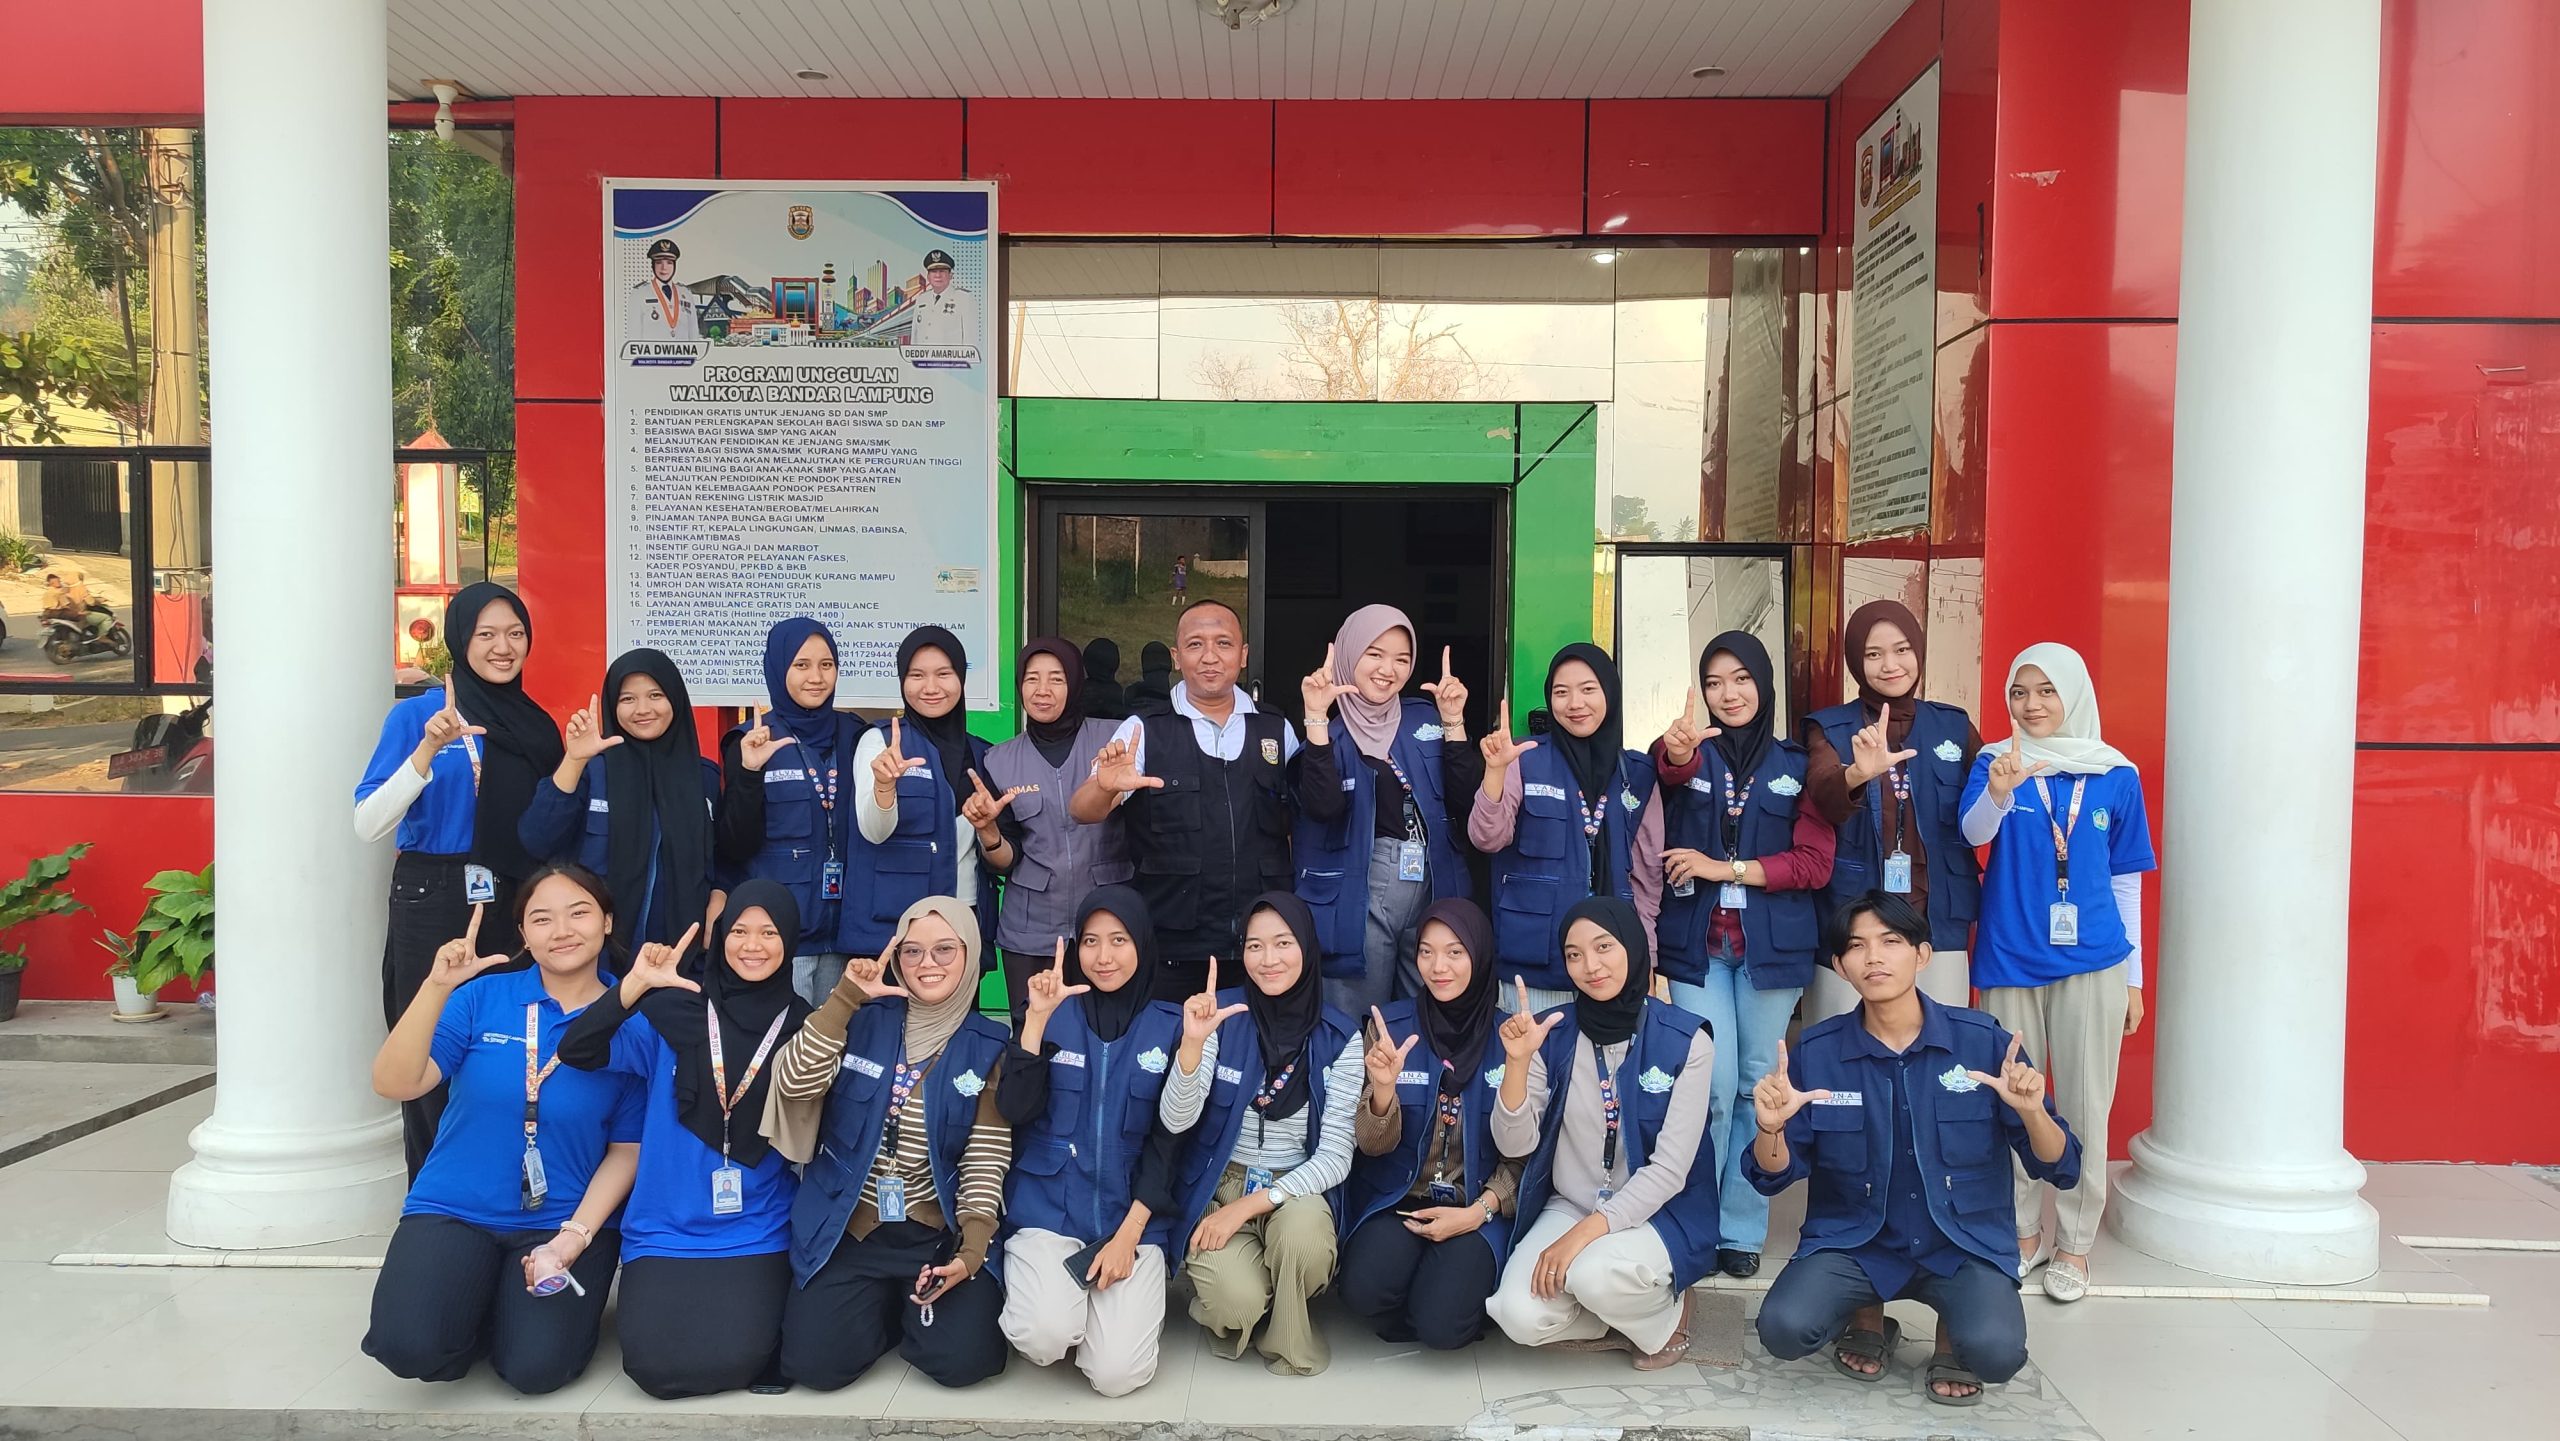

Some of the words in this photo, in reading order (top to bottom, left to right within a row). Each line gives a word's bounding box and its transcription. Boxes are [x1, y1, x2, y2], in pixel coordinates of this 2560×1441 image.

[630, 344, 651, 355] EVA
[654, 344, 698, 356] DWIANA
[905, 350, 929, 359] DEDDY
[930, 350, 976, 359] AMARULLAH
[704, 366, 793, 382] PROGRAM
[796, 367, 899, 384] UNGGULAN
[669, 385, 763, 402] WALIKOTA
[766, 386, 842, 403] BANDAR
[844, 387, 934, 404] LAMPUNG
[707, 409, 741, 417] GRATIS
[695, 419, 773, 427] PERLENGKAPAN
[853, 420, 883, 428] SISWA
[886, 420, 898, 428] SD
[902, 420, 922, 428] DAN
[720, 438, 779, 446] PENDIDIKAN
[645, 456, 711, 464] BERPRESTASI
[773, 457, 845, 465] MELANJUTKAN
[843, 476, 901, 484] PESANTREN
[709, 525, 746, 533] KEPALA
[820, 526, 858, 534] LINMAS,
[862, 526, 907, 534] BABINSA,
[692, 554, 744, 562] OPERATOR
[747, 554, 805, 562] PELAYANAN
[683, 563, 738, 571] POSYANDU,
[815, 573, 856, 581] KURANG
[647, 591, 721, 599] PEMBANGUNAN
[646, 610, 690, 618] JENAZAH
[846, 621, 876, 629] ANAK
[680, 629, 750, 637] MENURUNKAN
[735, 640, 767, 648] TANGG
[705, 668, 729, 676] JADI,
[732, 668, 765, 676] SERTA
[1005, 783, 1041, 795] INMAS
